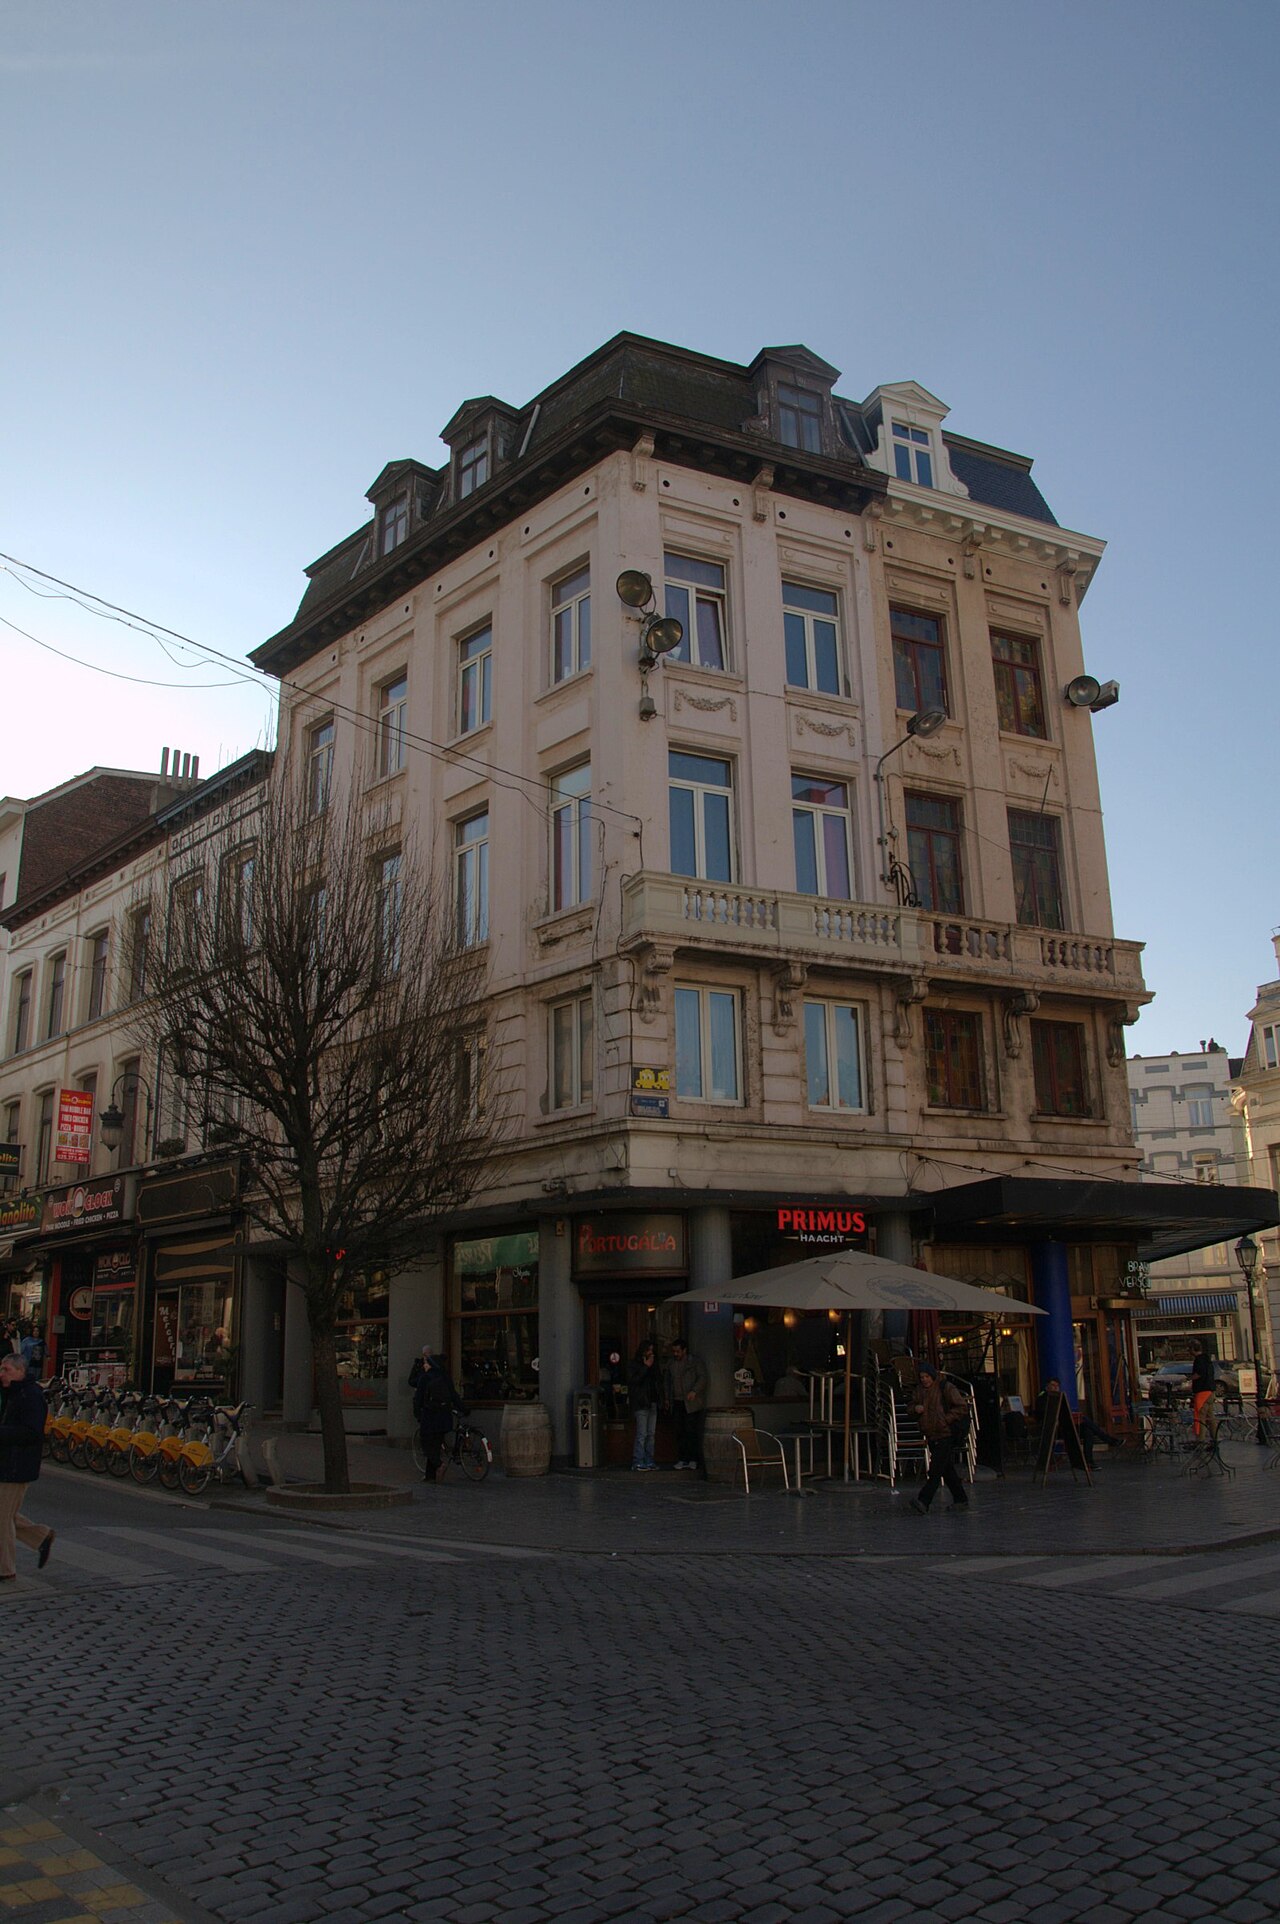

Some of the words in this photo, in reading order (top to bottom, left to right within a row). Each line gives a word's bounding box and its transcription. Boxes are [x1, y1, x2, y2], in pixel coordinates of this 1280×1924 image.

[53, 1200, 74, 1218] WOK
[54, 1220, 70, 1230] NOODLE
[73, 1217, 84, 1226] FRIED
[85, 1213, 103, 1224] CHICKEN
[106, 1210, 119, 1220] PIZZA
[777, 1209, 866, 1233] PRIMUS
[800, 1234, 845, 1243] HAACHT
